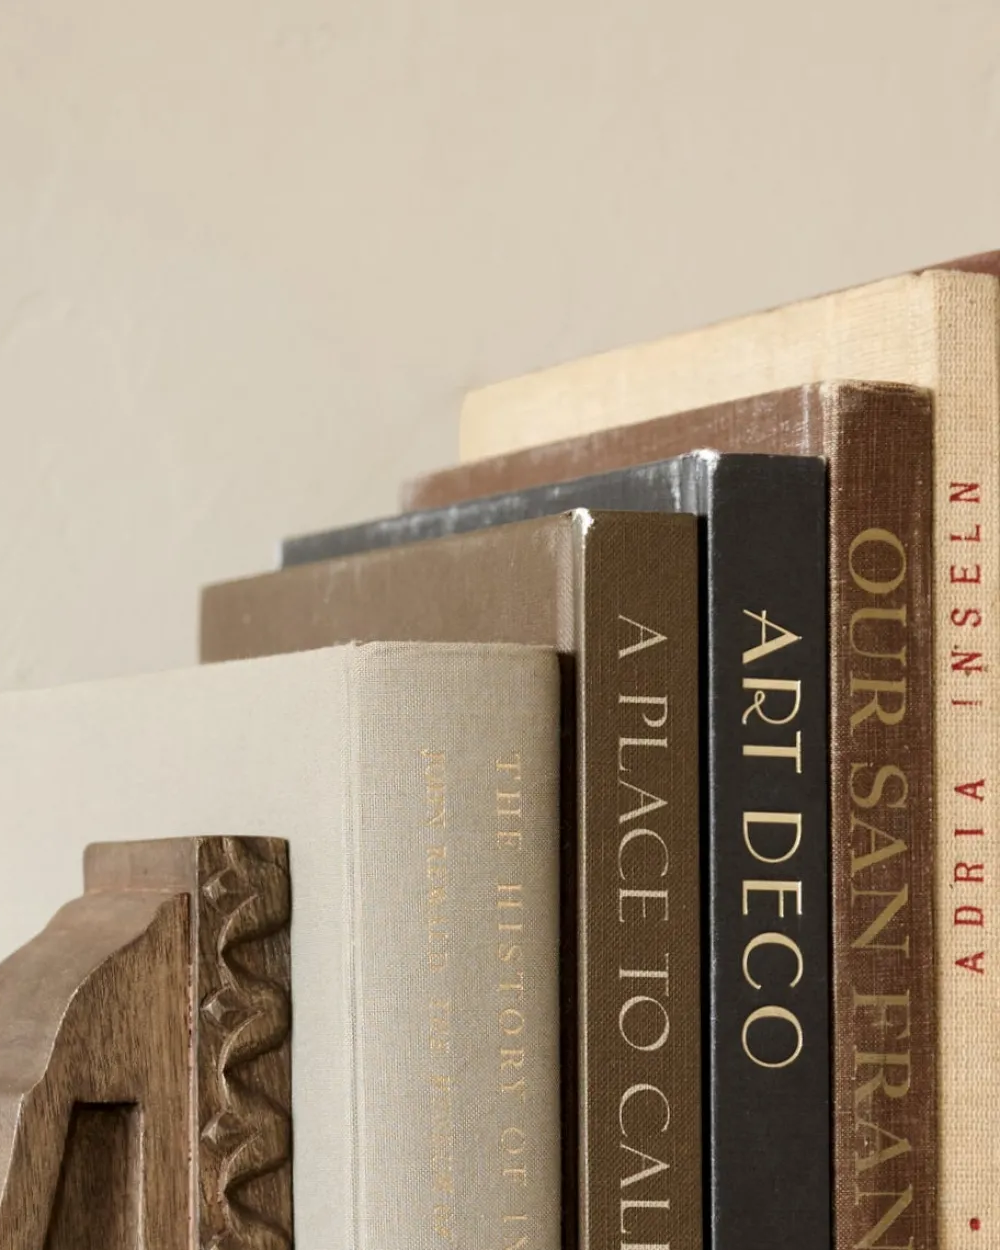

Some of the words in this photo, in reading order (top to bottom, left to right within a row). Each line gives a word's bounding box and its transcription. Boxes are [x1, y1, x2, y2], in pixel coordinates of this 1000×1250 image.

[618, 614, 669, 659] A
[741, 608, 803, 774] ART
[850, 528, 908, 736] OUR
[950, 481, 983, 707] INSELN
[496, 752, 522, 851] THE
[618, 693, 670, 923] PLACE
[850, 763, 909, 959] SAN
[953, 778, 986, 975] ADRIA
[497, 883, 526, 1103] HISTORY
[618, 952, 671, 1053] TO
[741, 811, 804, 1069] DECO
[500, 1126, 527, 1187] OF
